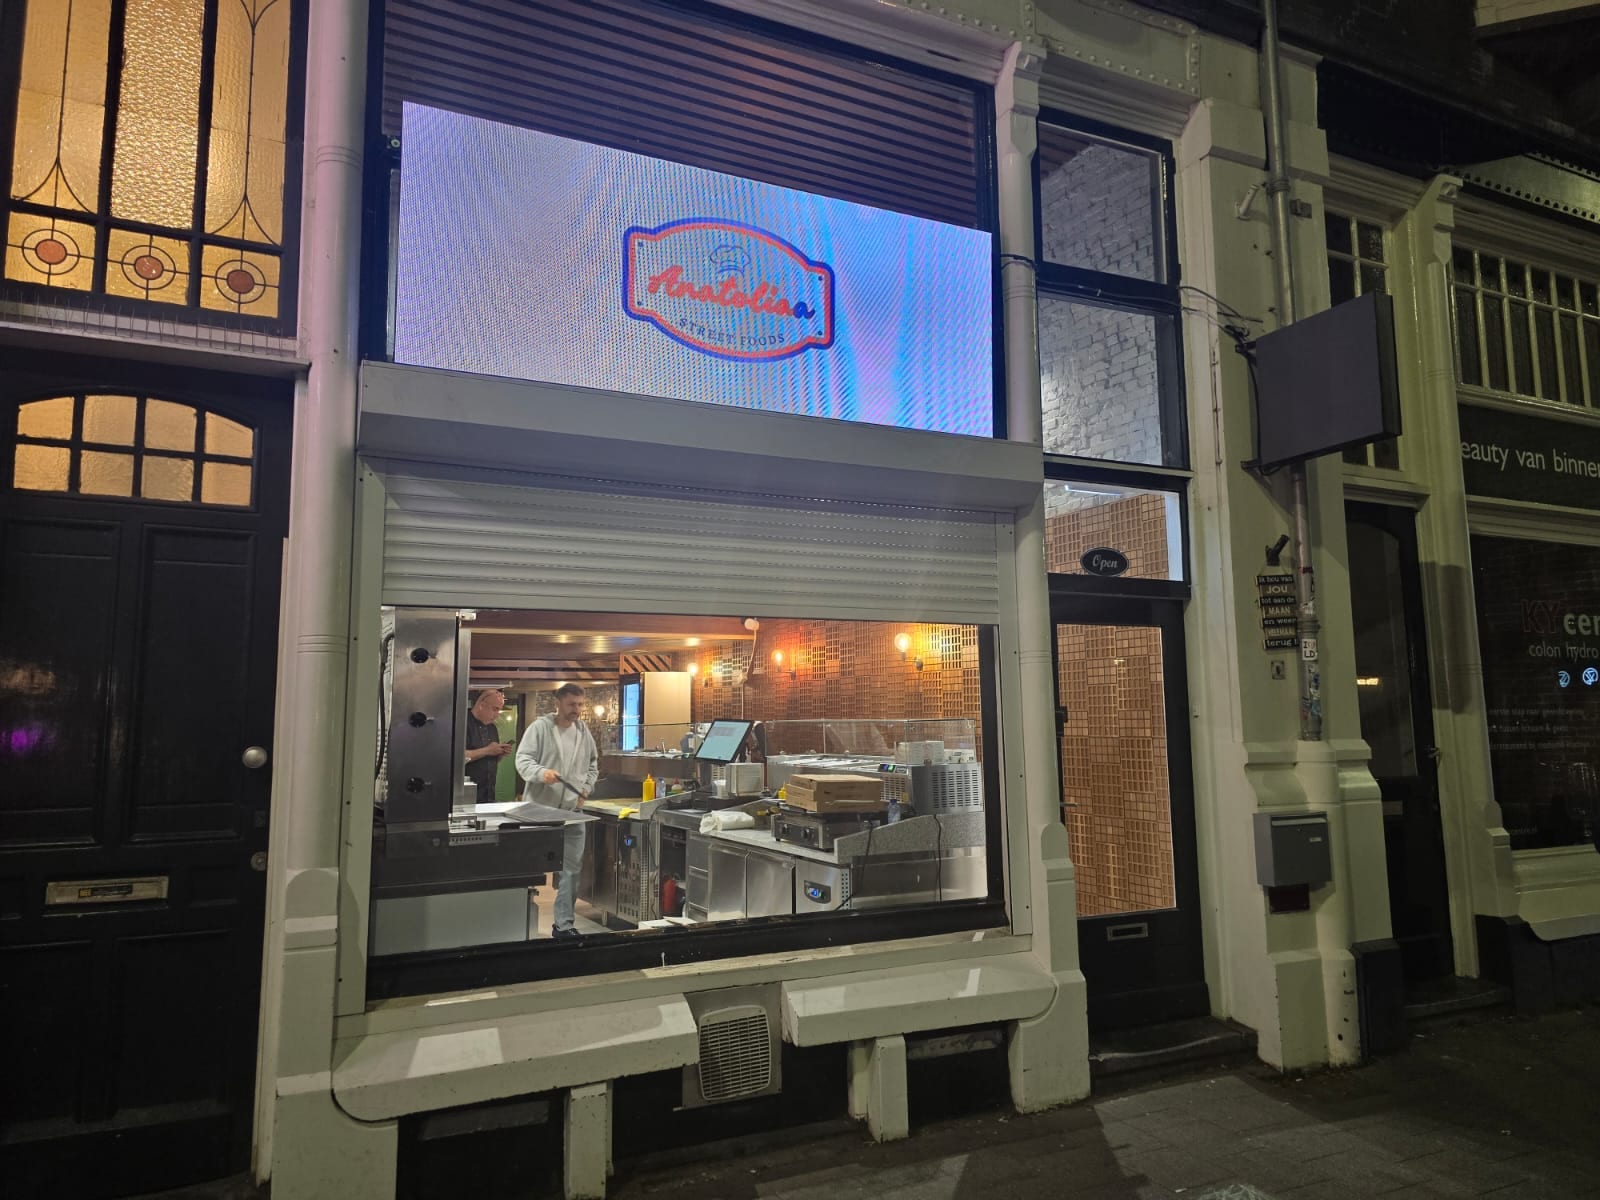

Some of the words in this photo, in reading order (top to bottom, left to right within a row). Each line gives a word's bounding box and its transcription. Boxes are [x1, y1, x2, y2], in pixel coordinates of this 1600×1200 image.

[680, 318, 734, 344] STREET
[740, 333, 785, 346] FOODS
[1516, 449, 1545, 470] van
[1553, 448, 1600, 478] binne
[1092, 554, 1118, 571] Open
[1266, 585, 1288, 594] JOU
[1266, 639, 1292, 647] terug
[1528, 640, 1561, 658] colon
